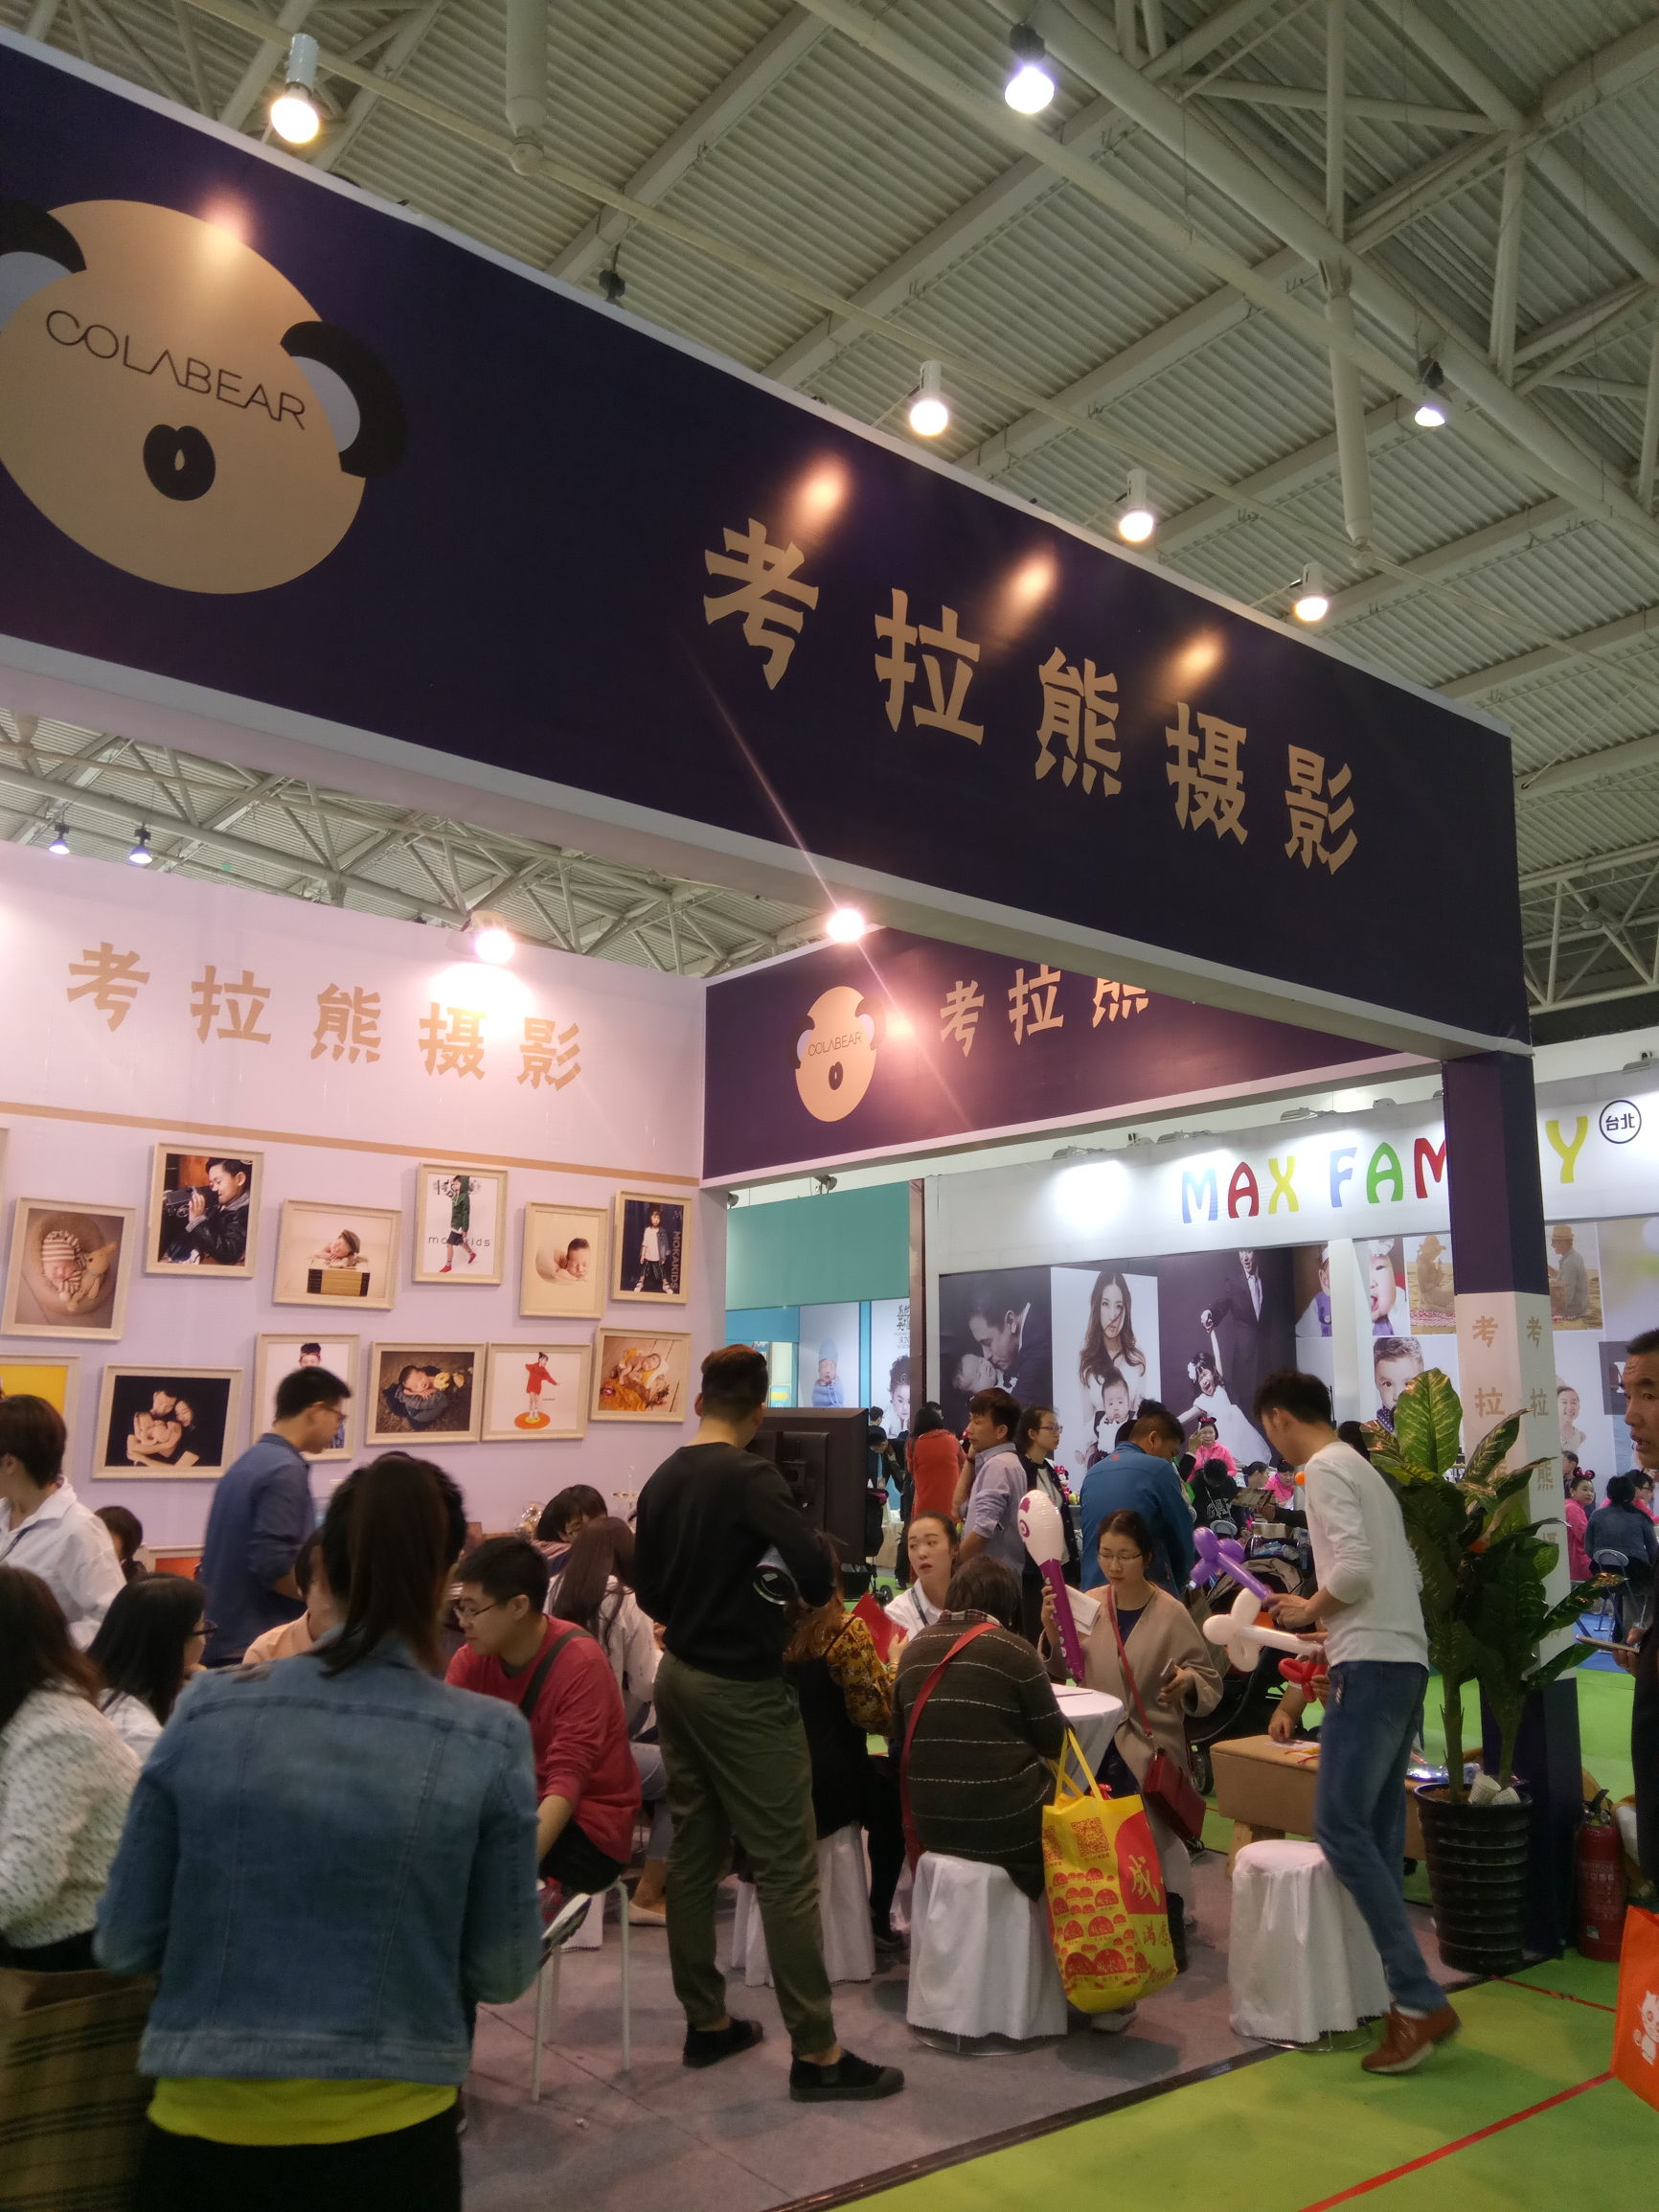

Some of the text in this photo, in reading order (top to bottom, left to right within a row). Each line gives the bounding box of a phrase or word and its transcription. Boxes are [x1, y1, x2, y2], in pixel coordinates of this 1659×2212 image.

[45, 309, 307, 431] COLABEAR
[702, 517, 1358, 875] 考拉熊摄影
[66, 941, 582, 1091] 考拉熊摄影
[807, 1031, 863, 1058] COLABEAR
[1181, 1115, 1589, 1224] MAX FAMY
[1605, 1112, 1636, 1131] 台北
[670, 1230, 682, 1289] MOKAKIDS
